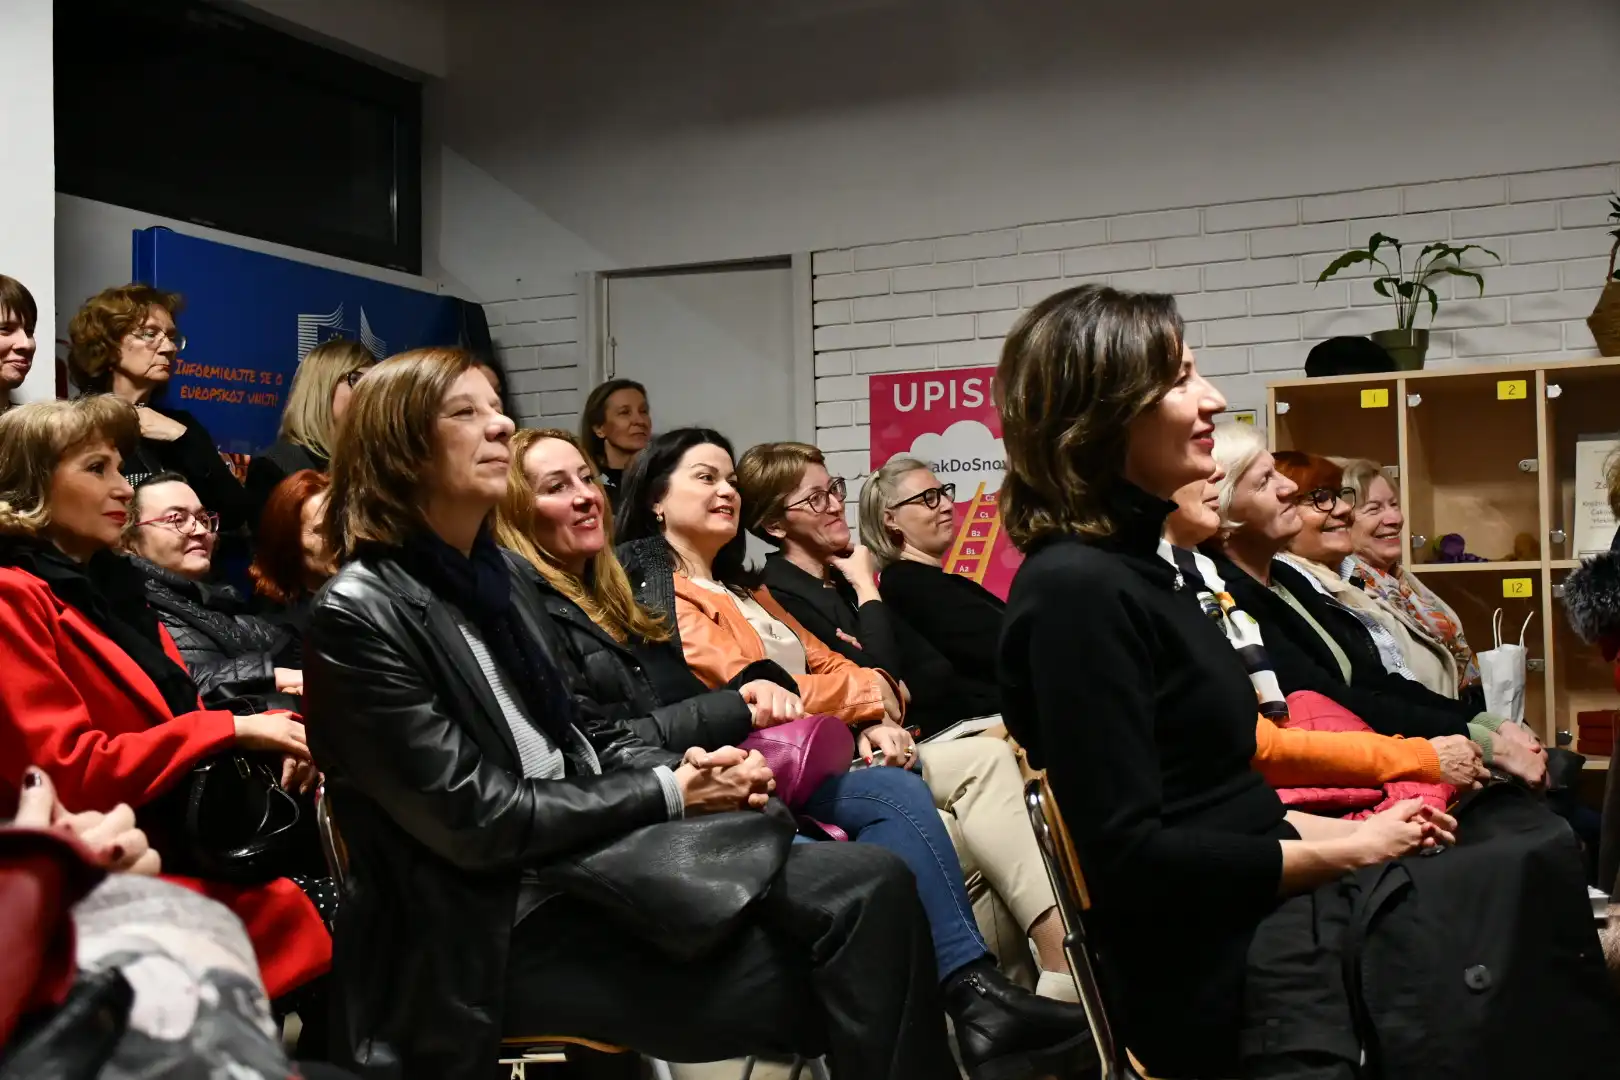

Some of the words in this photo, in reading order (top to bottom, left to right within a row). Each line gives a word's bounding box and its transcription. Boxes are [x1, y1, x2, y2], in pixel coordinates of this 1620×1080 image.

[175, 359, 256, 383] INFORMIRAJTE
[260, 371, 273, 385] SE
[275, 373, 283, 386] O
[180, 384, 245, 404] EUROPSKOJ
[1508, 384, 1516, 396] 2
[980, 511, 989, 519] C1
[966, 547, 976, 555] B1
[960, 565, 969, 573] A2
[1511, 582, 1523, 593] 12
